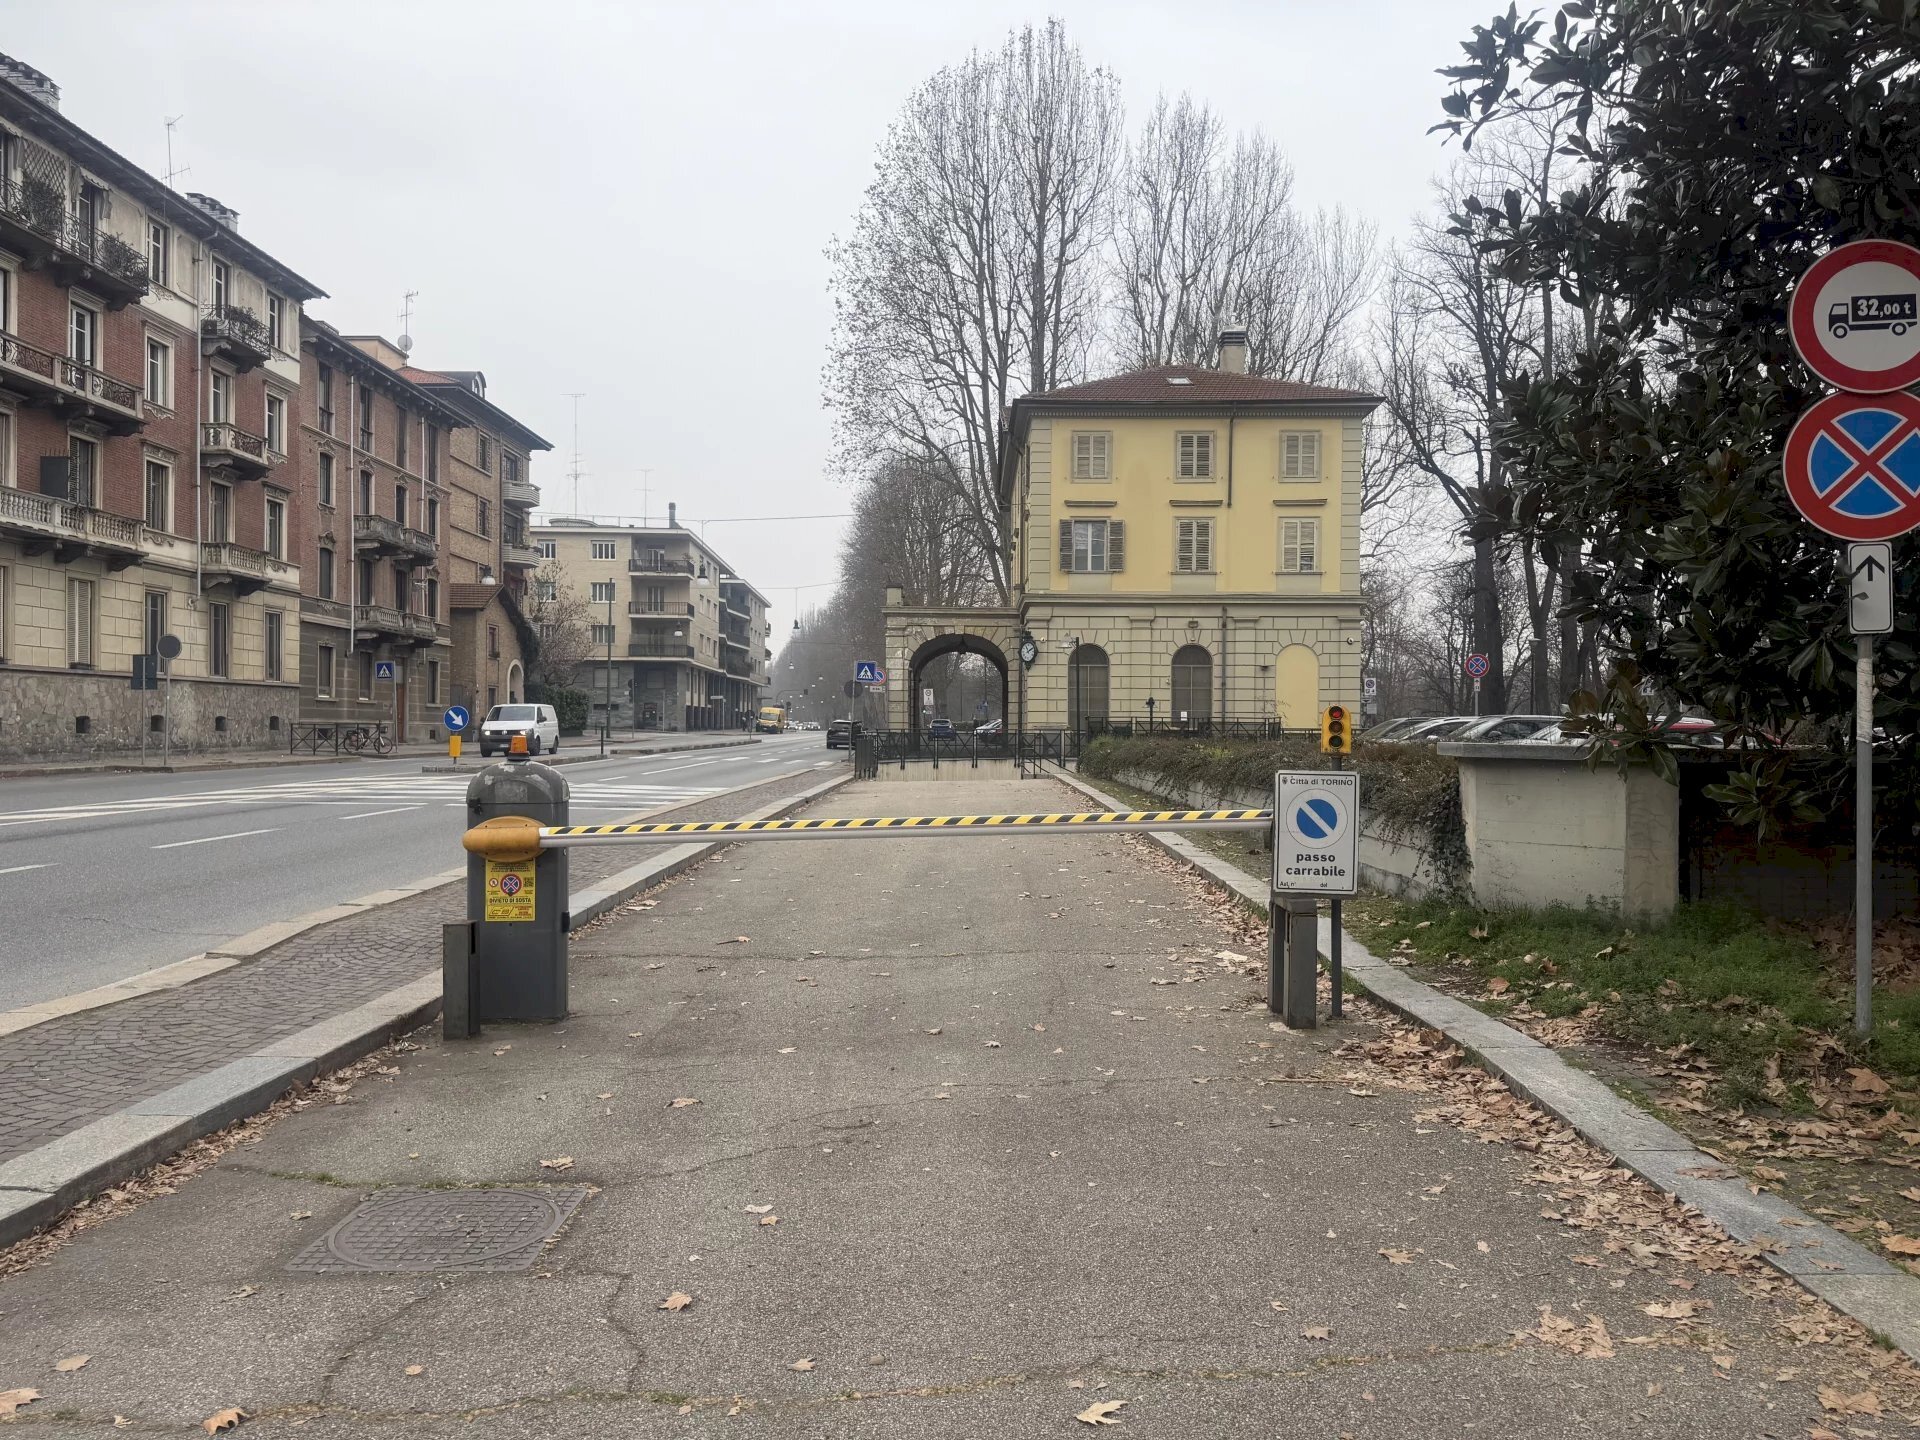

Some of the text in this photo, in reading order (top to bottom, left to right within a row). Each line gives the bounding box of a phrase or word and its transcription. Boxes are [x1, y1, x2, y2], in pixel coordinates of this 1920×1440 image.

[1857, 298, 1911, 318] 32,00 t
[1320, 778, 1353, 786] TORINO
[1296, 853, 1336, 863] passo
[1286, 866, 1346, 876] carrabile
